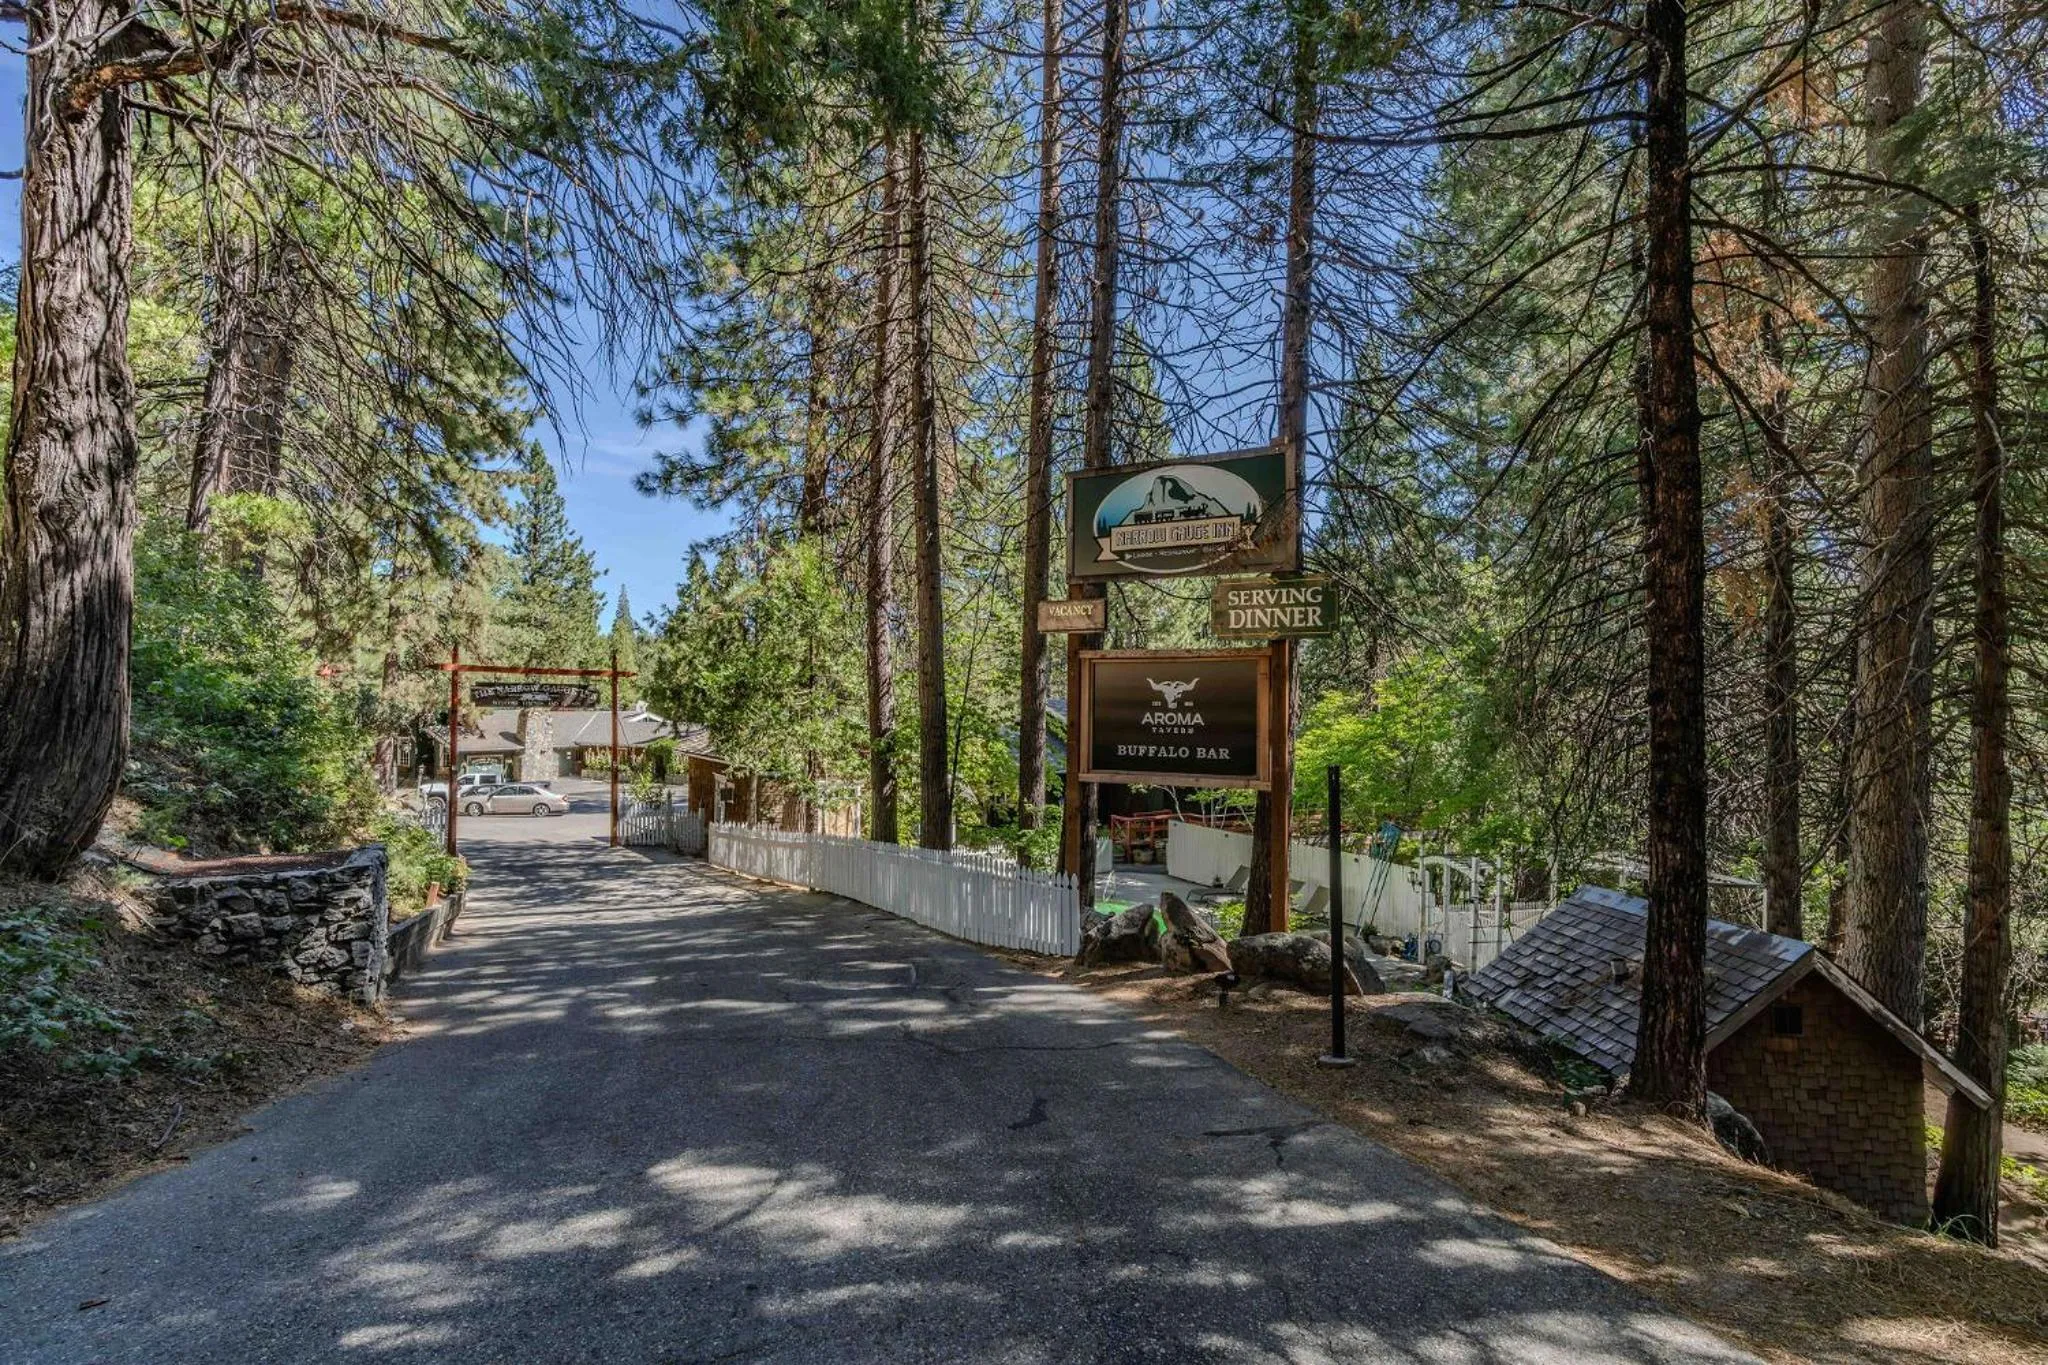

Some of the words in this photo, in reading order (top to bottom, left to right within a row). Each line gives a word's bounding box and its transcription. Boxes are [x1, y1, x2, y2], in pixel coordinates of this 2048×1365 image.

[1116, 526, 1167, 547] NARROW
[1170, 524, 1209, 542] GAUGE
[1212, 521, 1235, 539] INN
[1228, 586, 1322, 606] SERVING
[1049, 604, 1093, 617] VACANCY
[1228, 606, 1323, 629] DINNER
[1141, 712, 1205, 726] AROMA
[1117, 745, 1190, 758] BUFFALO
[1196, 747, 1231, 760] BAR
